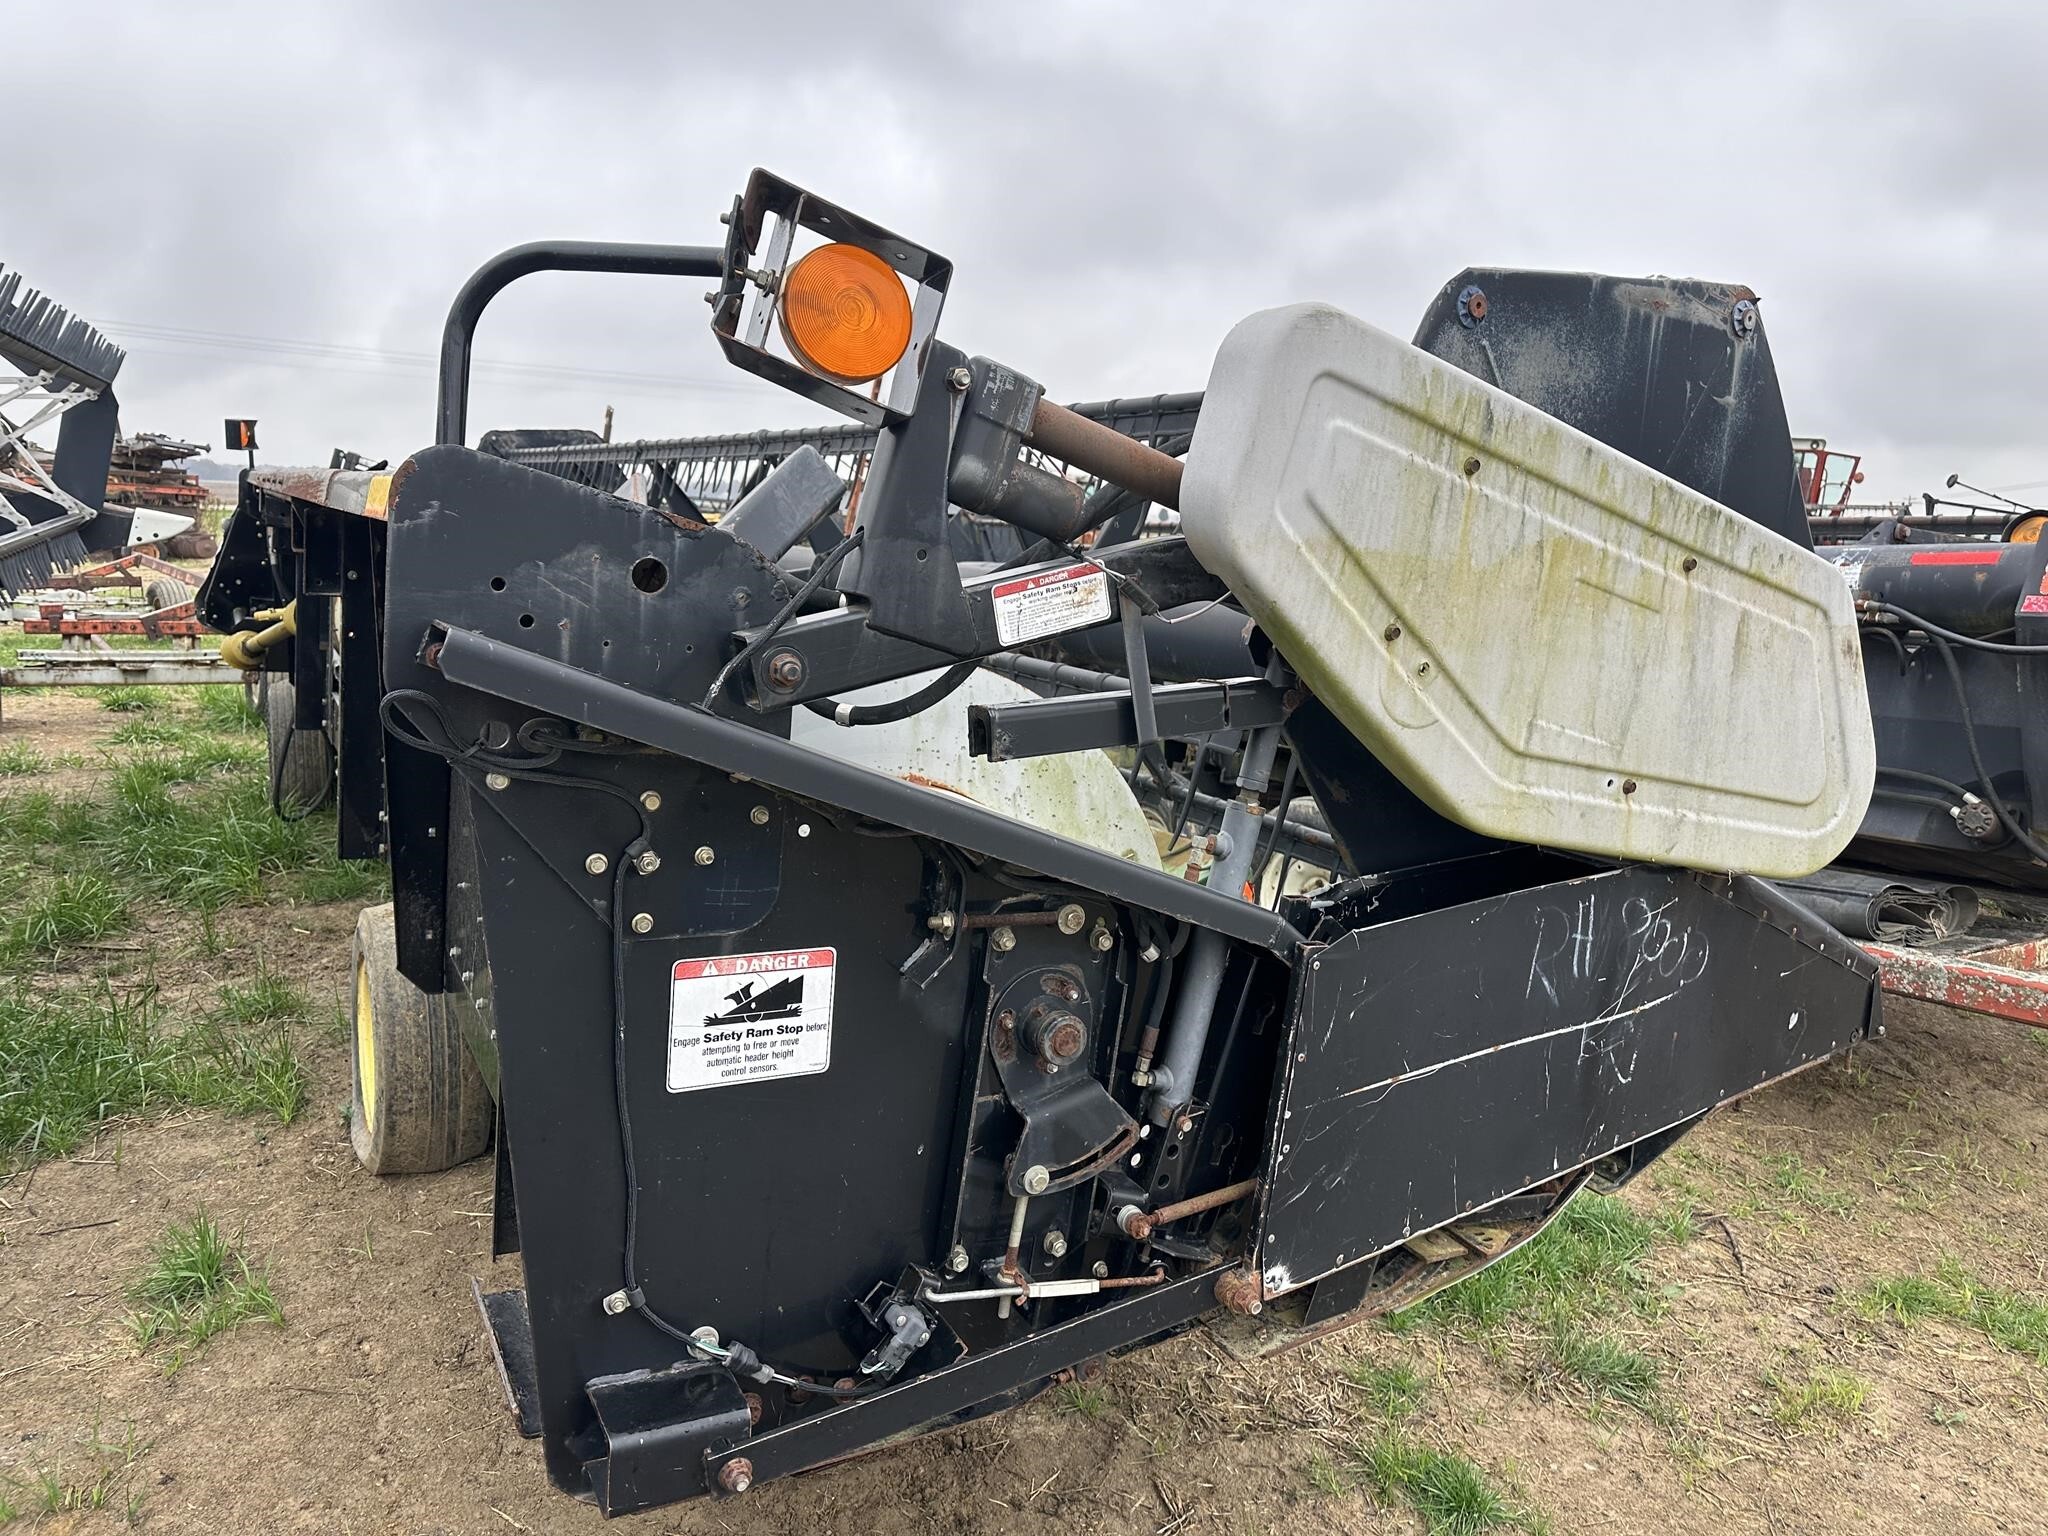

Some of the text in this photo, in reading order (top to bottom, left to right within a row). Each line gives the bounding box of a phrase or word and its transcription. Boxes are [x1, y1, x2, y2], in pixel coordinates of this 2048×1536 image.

[1039, 572, 1068, 585] DANGER
[1022, 590, 1044, 600] Safety
[1045, 586, 1061, 594] Ram
[1062, 581, 1081, 590] Stops
[735, 954, 810, 974] DANGER
[673, 1022, 827, 1049] Engage Safety Ram Stop before
[701, 1037, 800, 1056] attempting to free or move
[706, 1049, 794, 1068] automatic header height
[721, 1066, 747, 1077] control
